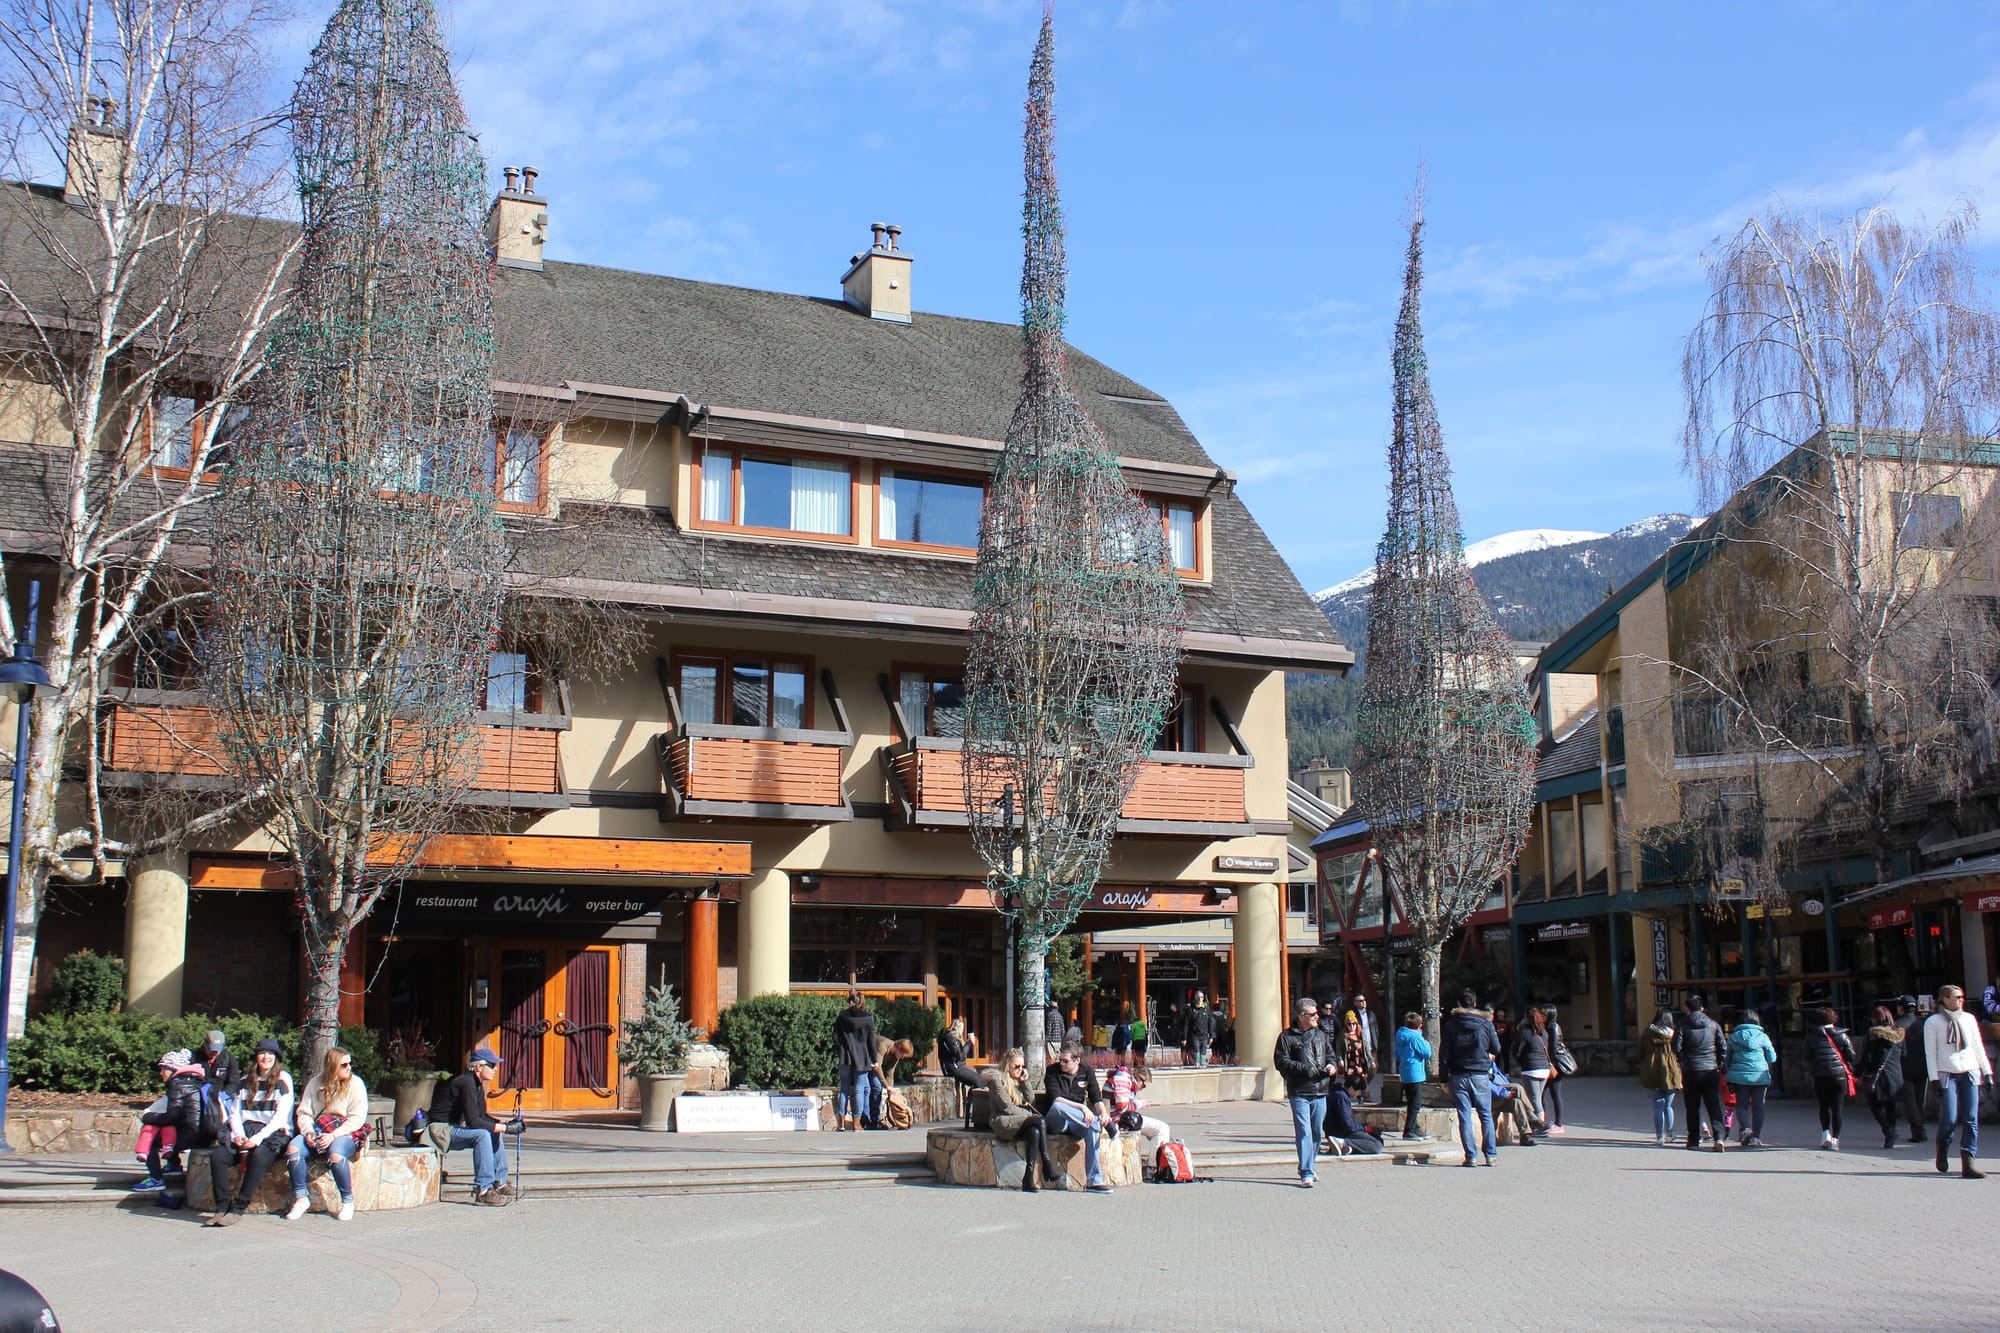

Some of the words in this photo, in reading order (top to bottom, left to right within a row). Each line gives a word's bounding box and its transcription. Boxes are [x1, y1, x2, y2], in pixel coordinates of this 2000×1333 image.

[415, 895, 478, 908] restaurant
[493, 887, 568, 918] araxi
[1102, 887, 1151, 909] araxi
[585, 898, 622, 912] oyster
[623, 899, 645, 911] bar
[1538, 928, 1562, 938] WHISTLER
[1562, 927, 1589, 937] HARDWARE
[780, 1106, 809, 1114] SUNDAY
